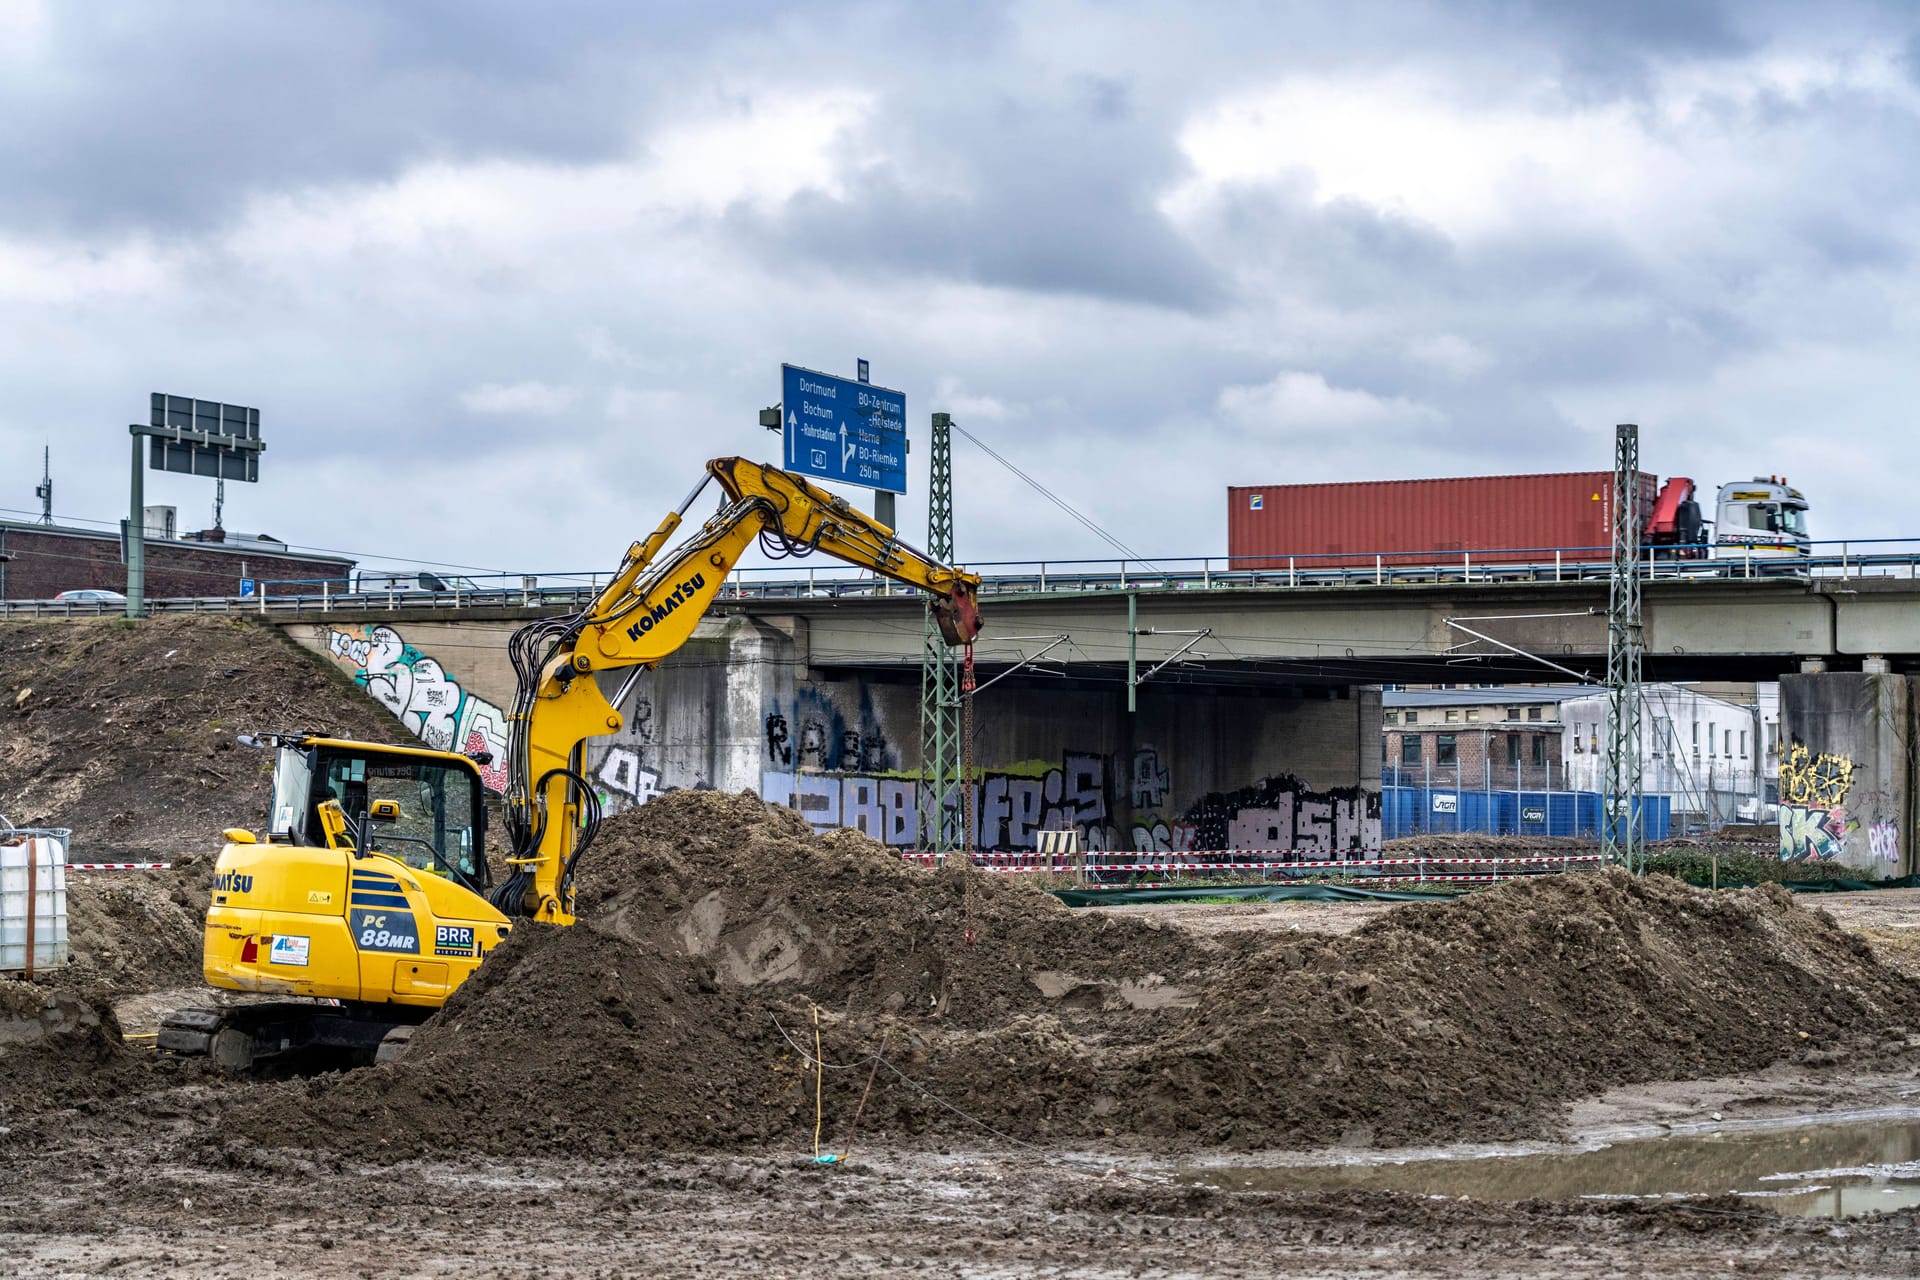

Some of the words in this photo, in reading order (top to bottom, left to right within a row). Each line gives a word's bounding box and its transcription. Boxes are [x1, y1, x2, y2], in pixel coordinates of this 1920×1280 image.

[800, 377, 836, 399] Dortmund
[803, 400, 833, 420] Bochum
[858, 392, 901, 415] BO-Zentrum
[815, 453, 823, 465] 40
[859, 446, 898, 467] BO-Riemke
[859, 464, 872, 478] 250
[872, 470, 880, 481] m
[362, 915, 387, 929] PC
